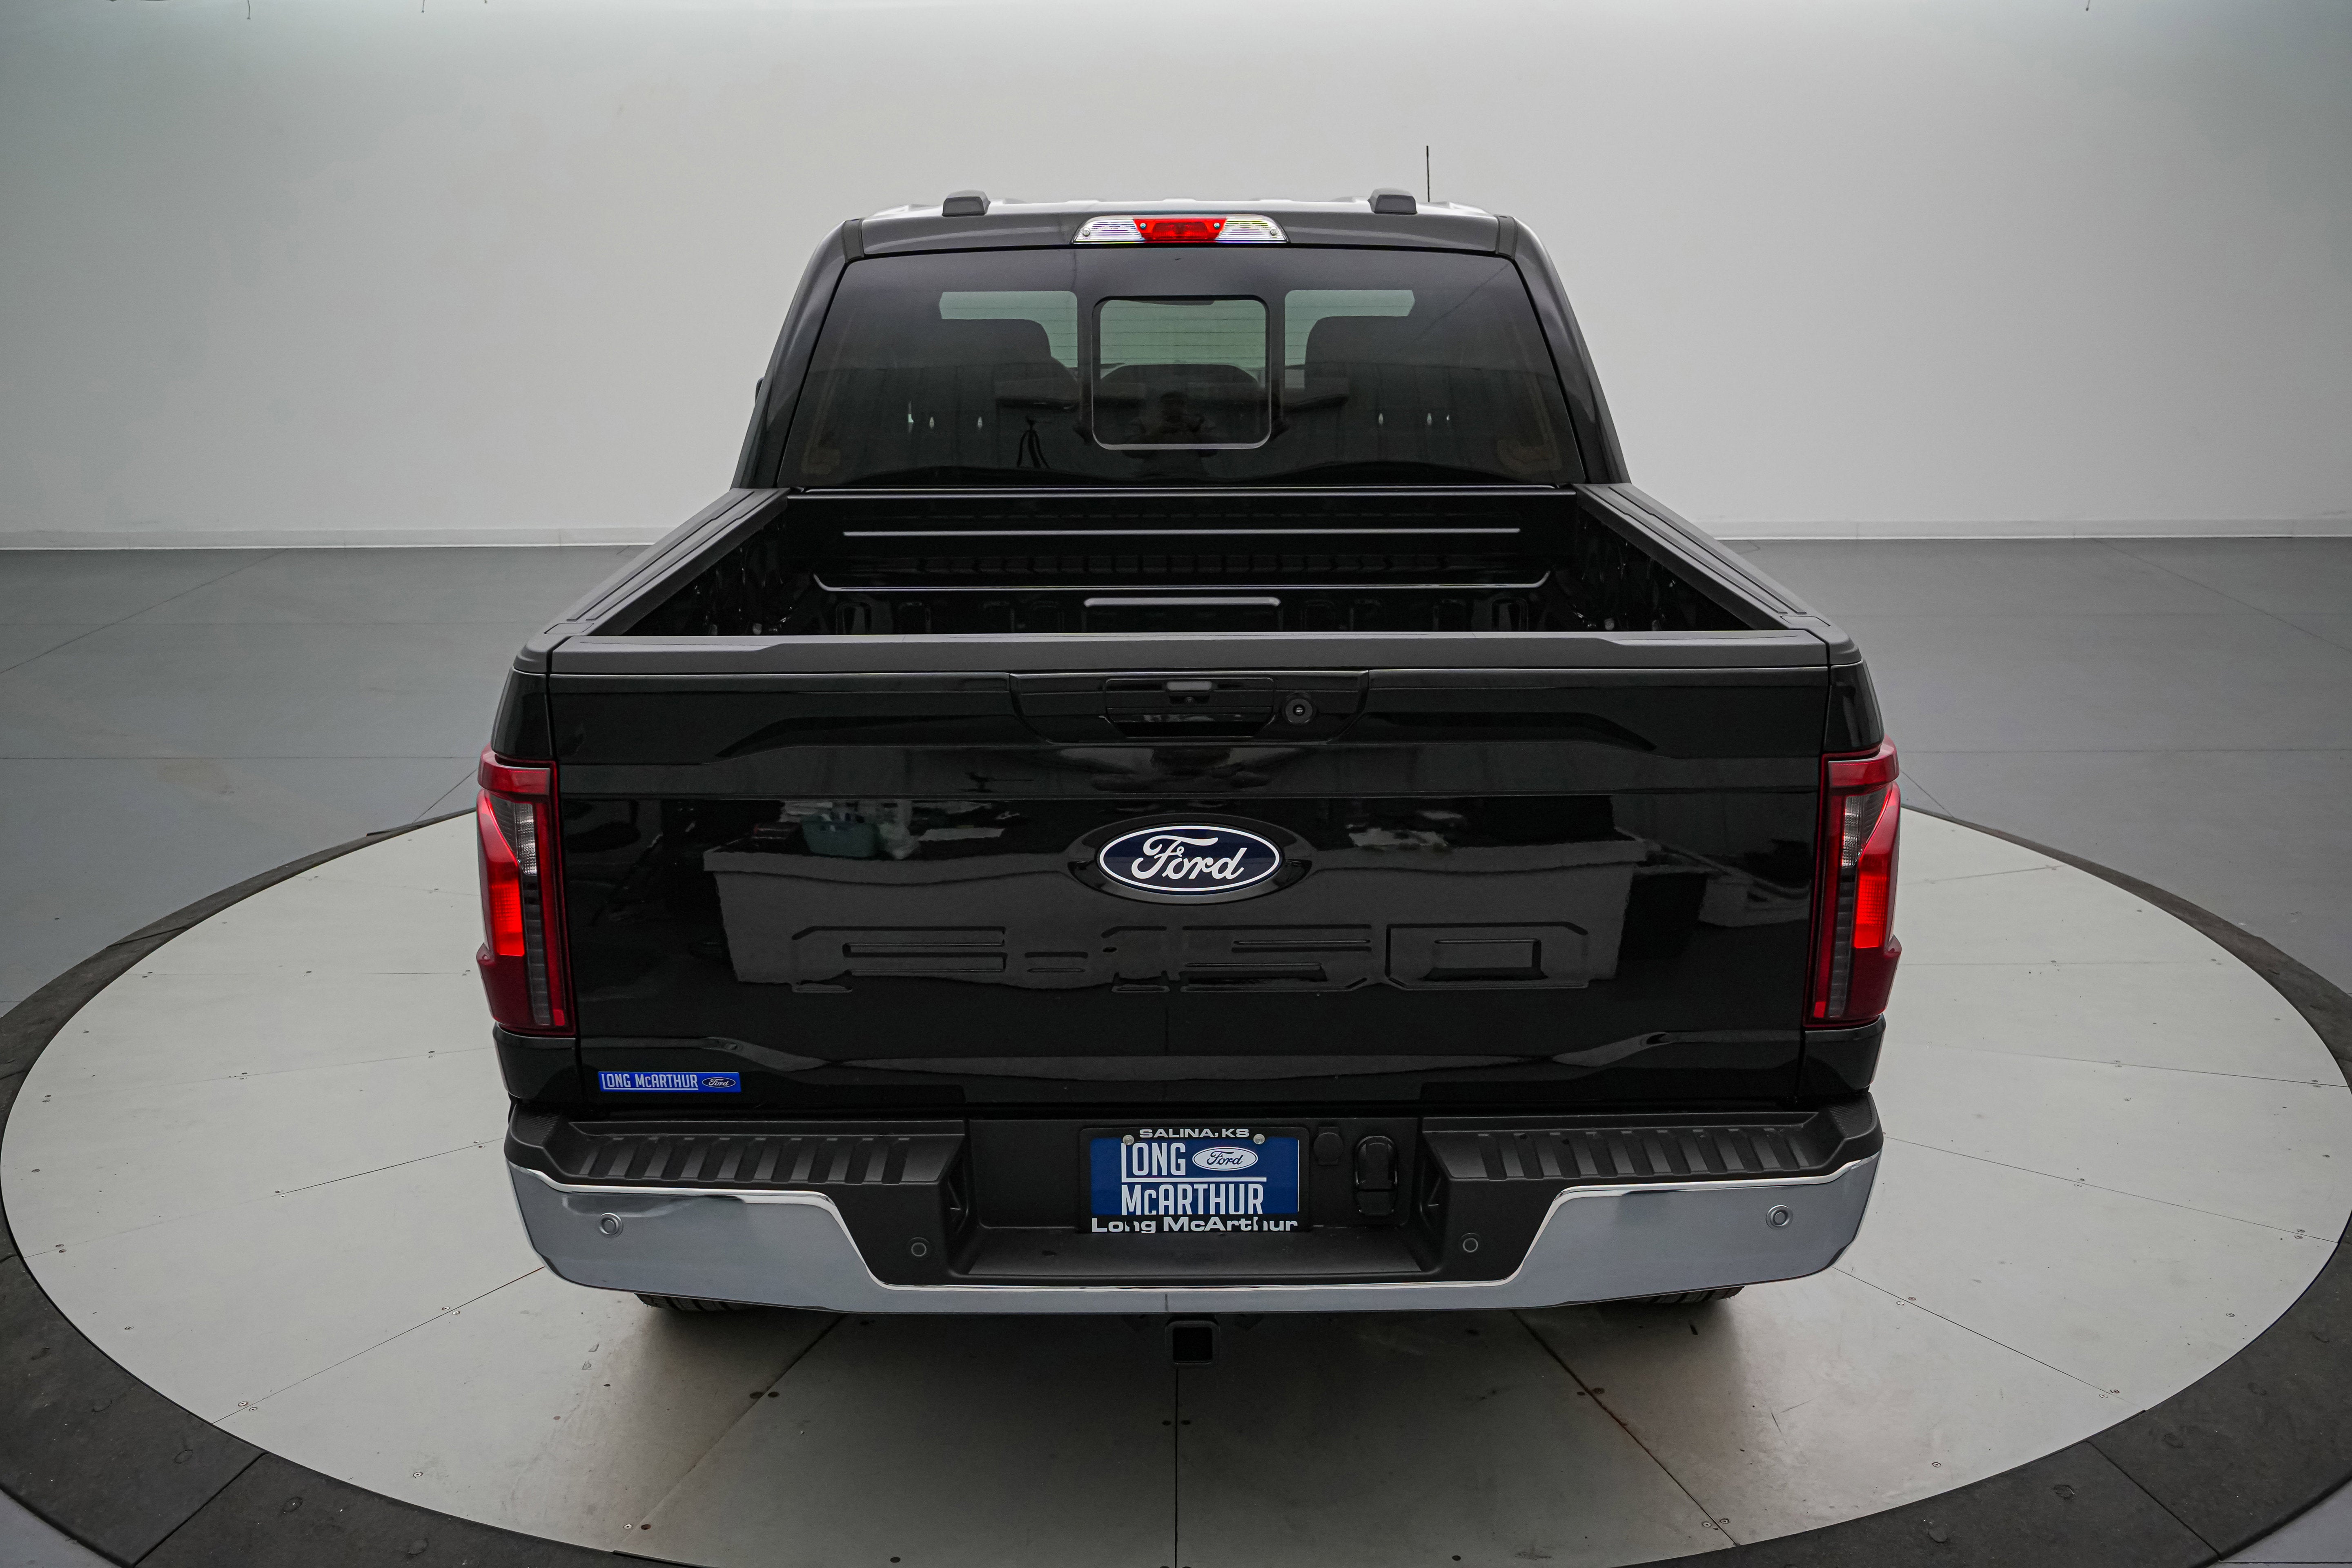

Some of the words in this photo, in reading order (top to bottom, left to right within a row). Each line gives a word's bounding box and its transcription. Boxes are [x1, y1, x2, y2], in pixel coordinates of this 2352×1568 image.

[1131, 835, 1247, 879] Ford
[601, 1074, 631, 1090] LONG
[635, 1074, 698, 1088] McARTHUR
[1222, 1129, 1250, 1138] KS
[1121, 1143, 1186, 1182] LONG
[1206, 1151, 1244, 1165] Ford
[1121, 1184, 1263, 1215] McARTHUR
[1091, 1218, 1156, 1233] Long
[1163, 1216, 1298, 1231] McArthur
